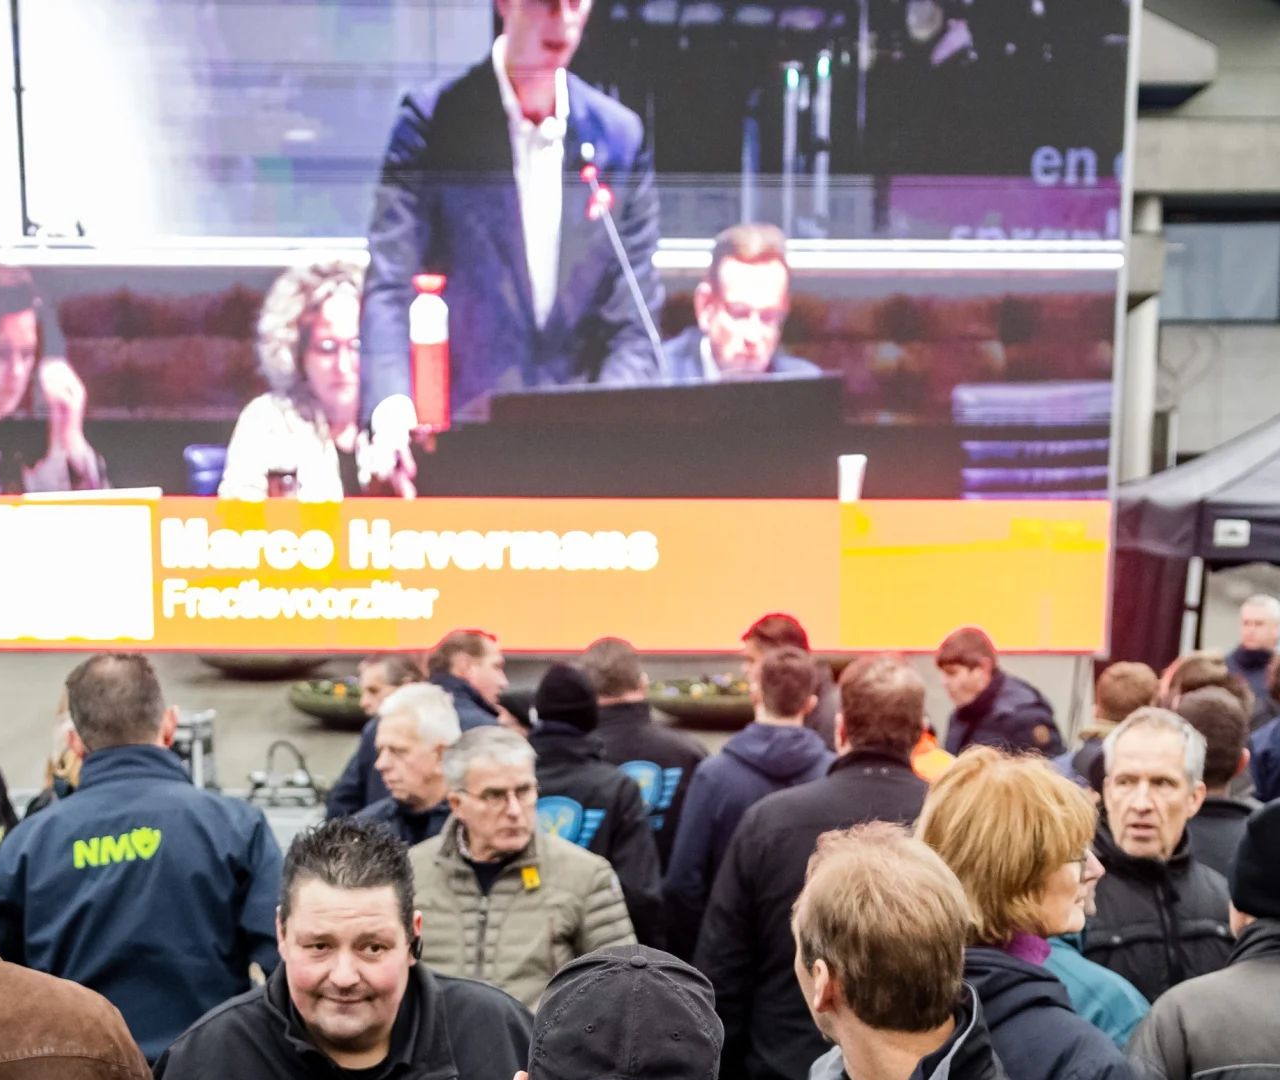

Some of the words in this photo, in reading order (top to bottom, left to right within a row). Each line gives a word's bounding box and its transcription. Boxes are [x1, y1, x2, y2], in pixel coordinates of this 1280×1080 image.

[1030, 145, 1098, 187] en
[161, 518, 334, 569] Marco
[349, 519, 659, 570] Havermans
